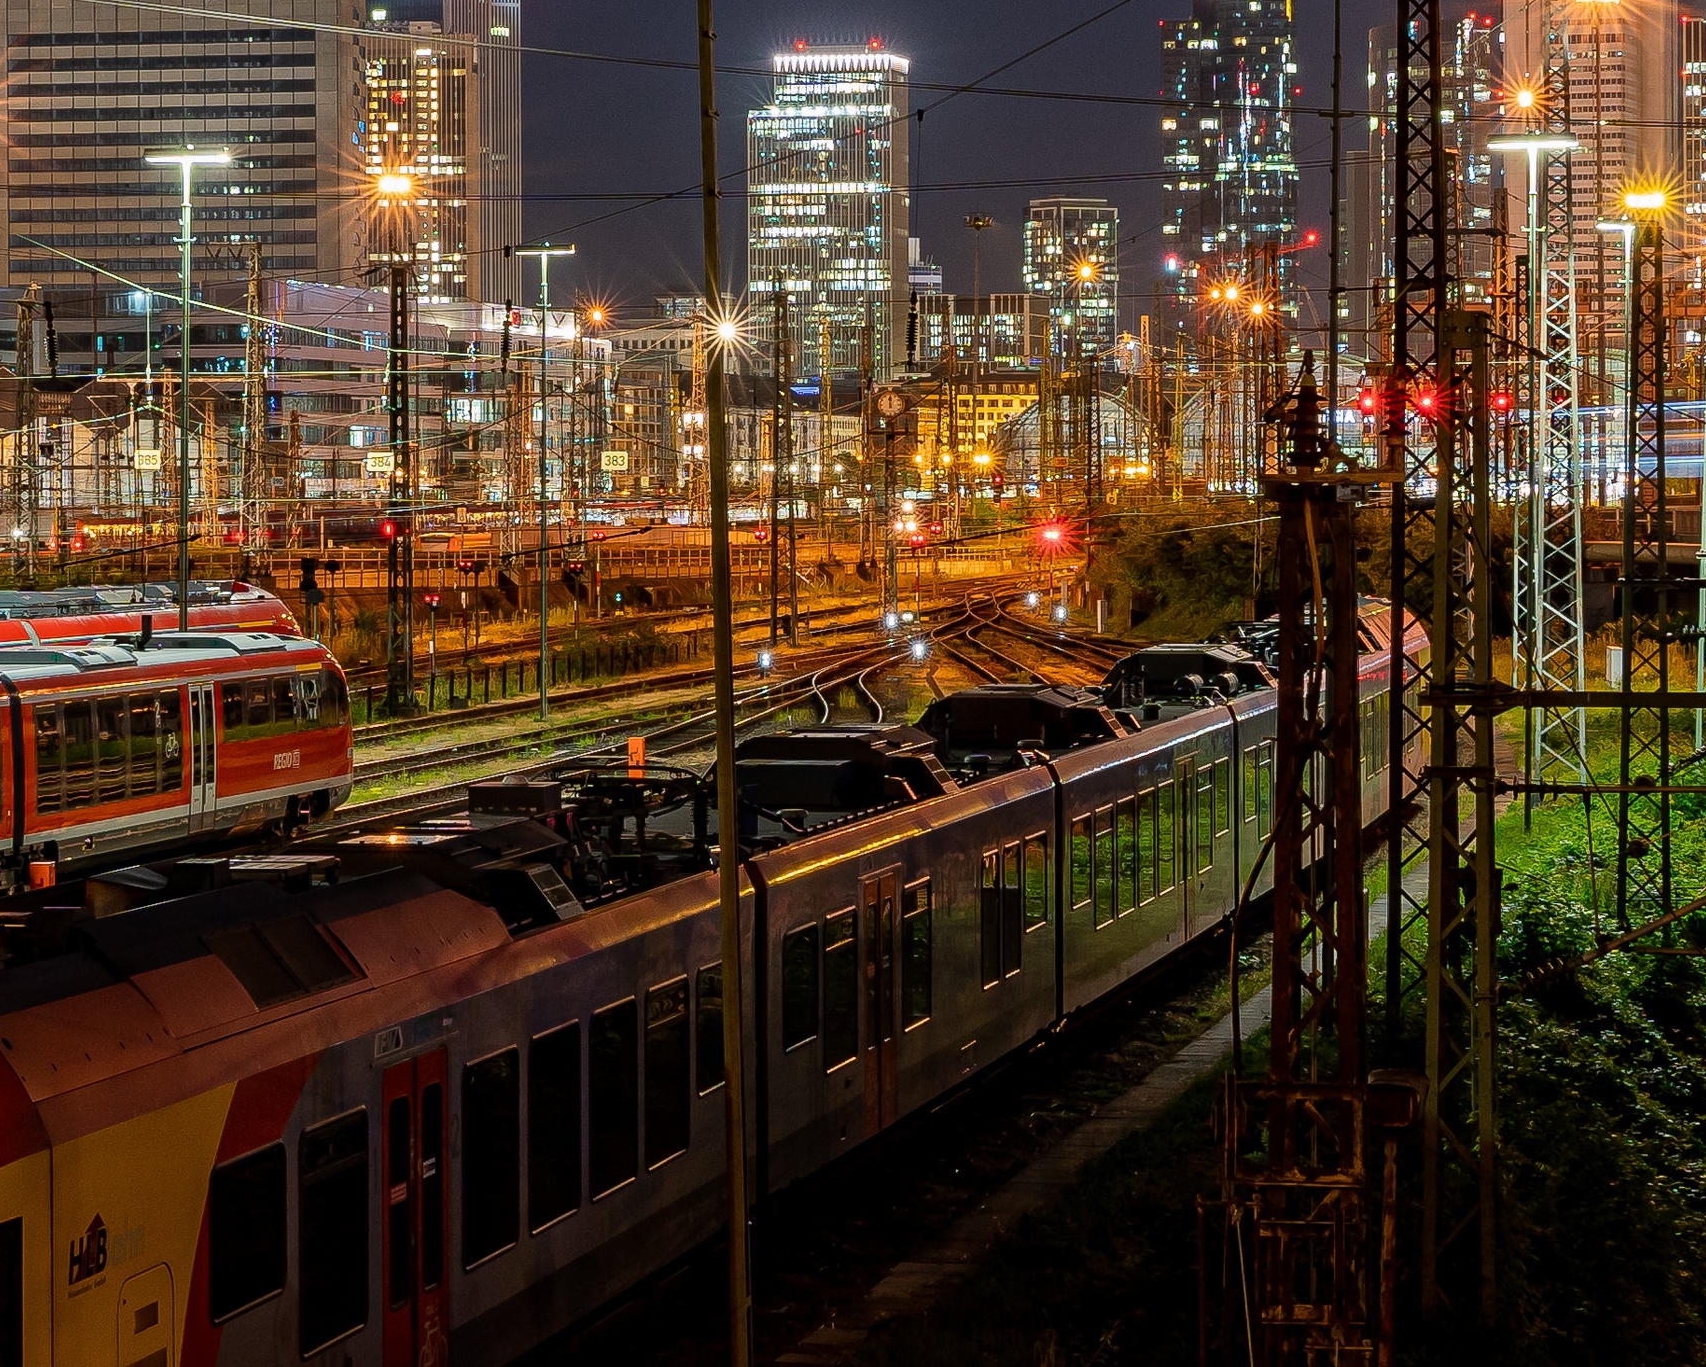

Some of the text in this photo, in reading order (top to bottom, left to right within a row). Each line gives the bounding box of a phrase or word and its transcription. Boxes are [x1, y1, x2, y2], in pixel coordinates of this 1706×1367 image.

[370, 455, 391, 468] 384
[604, 454, 625, 467] 383
[68, 1226, 108, 1285] HLB
